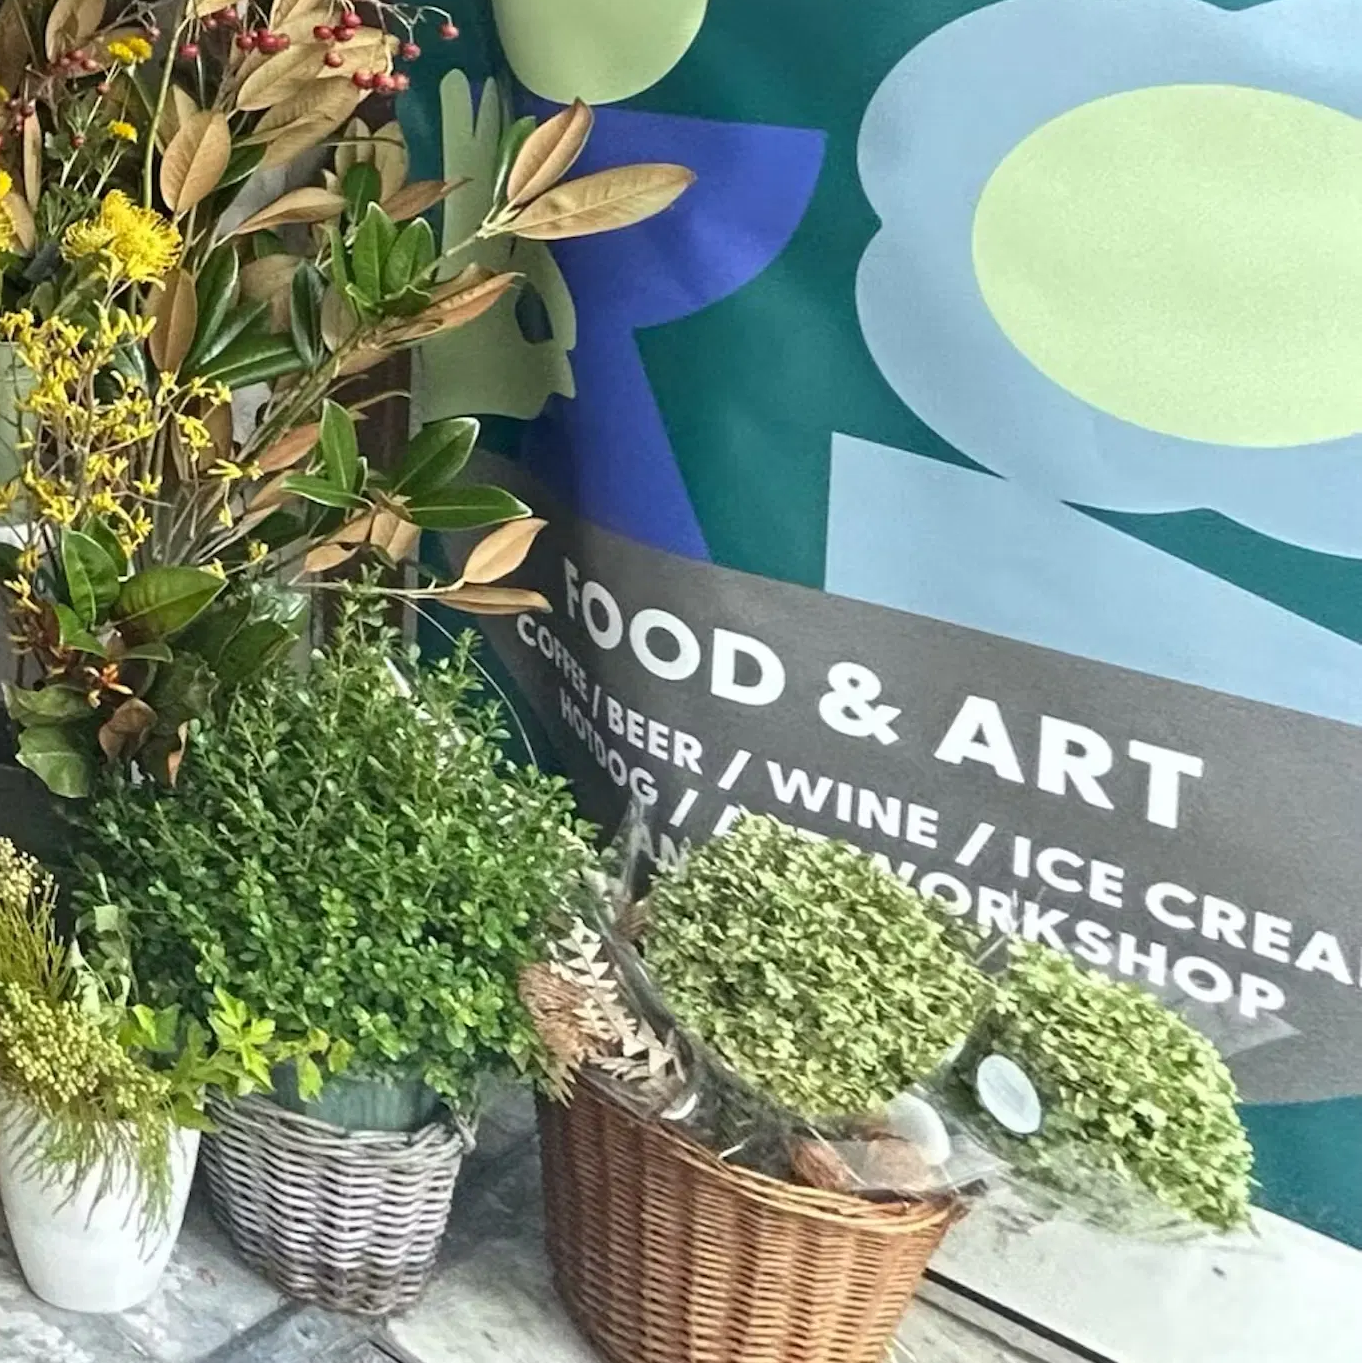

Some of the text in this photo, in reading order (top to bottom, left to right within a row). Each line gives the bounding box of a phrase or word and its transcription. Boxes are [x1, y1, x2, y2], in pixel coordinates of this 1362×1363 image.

[516, 613, 588, 703] COFFEE
[606, 695, 704, 776] BEER
[766, 760, 940, 850] WINE
[1012, 835, 1125, 909] ICE
[1144, 881, 1362, 988] CREA
[559, 687, 659, 807] HOTDOG
[563, 556, 1205, 831] FOOD & ART
